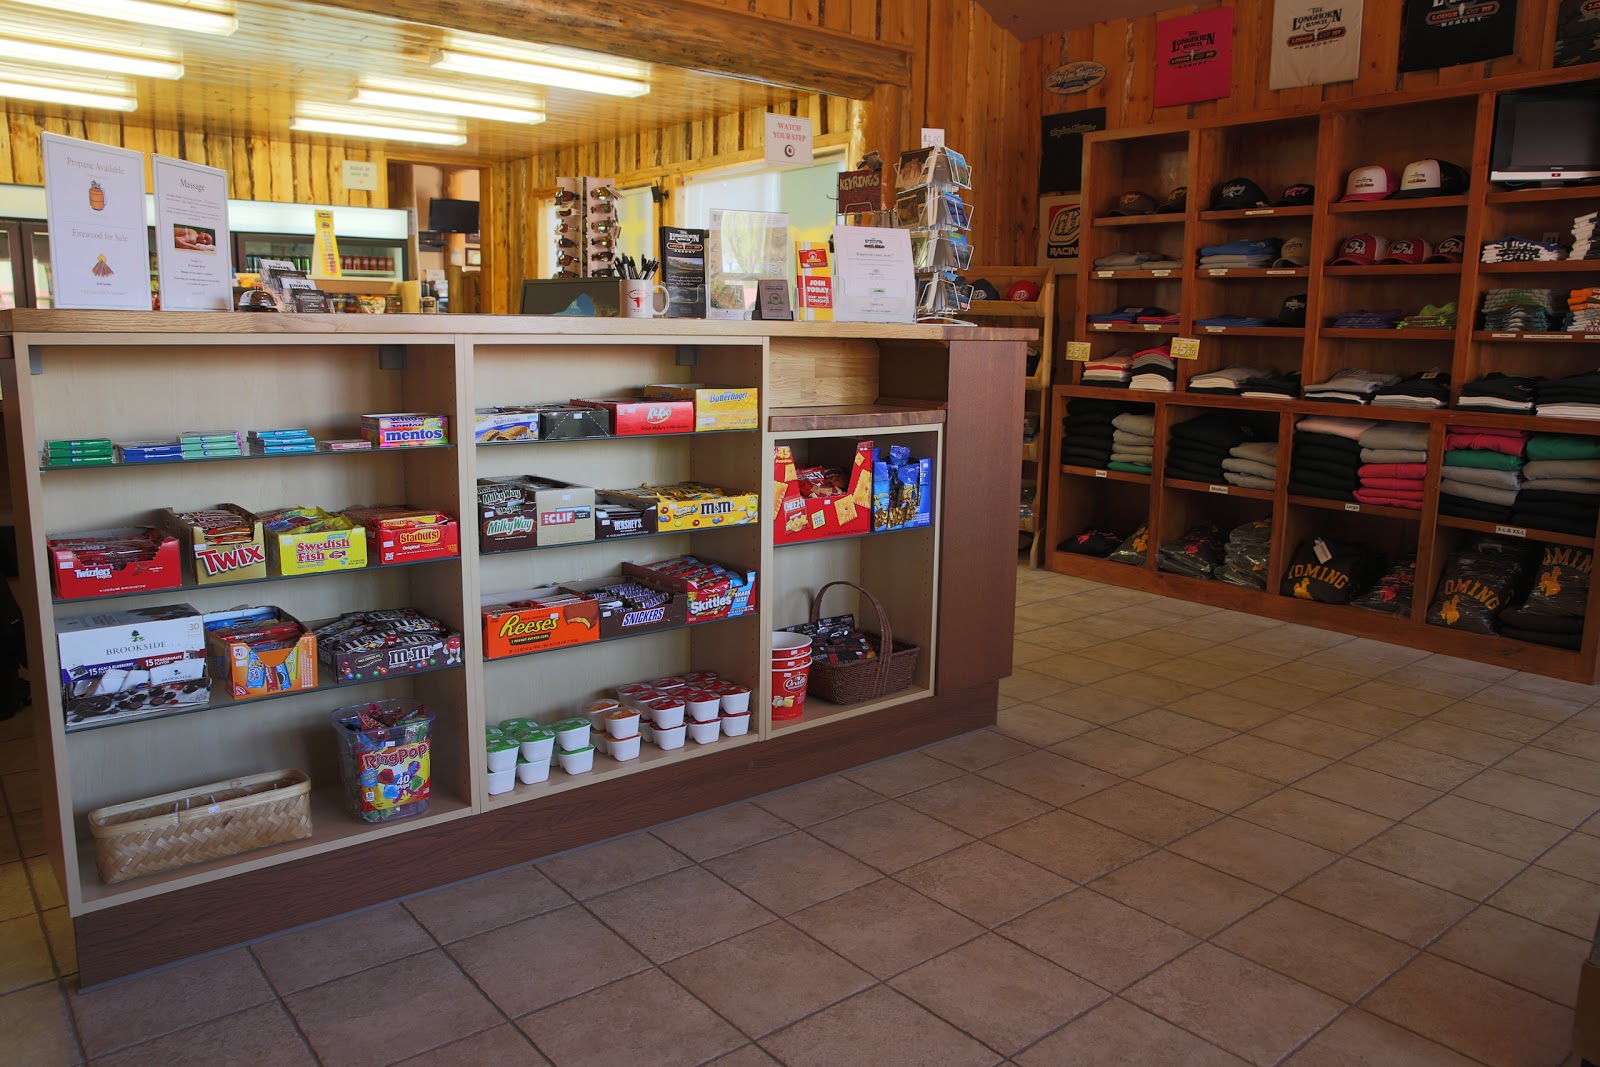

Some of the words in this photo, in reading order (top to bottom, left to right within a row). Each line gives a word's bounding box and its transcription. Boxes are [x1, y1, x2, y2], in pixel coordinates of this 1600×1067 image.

[1292, 8, 1342, 31] LONGHORN
[1431, 11, 1459, 20] LODGE
[1440, 16, 1482, 28] RESORT
[1172, 32, 1215, 52] LONGHORN
[777, 122, 802, 131] WATCH
[772, 131, 791, 140] YOUR
[791, 133, 807, 142] STEP
[67, 157, 94, 170] Propane
[96, 163, 125, 175] Available
[180, 179, 205, 192] Massage
[839, 173, 880, 191] KEYRINGS
[72, 229, 103, 240] Firewood
[104, 233, 113, 241] for
[114, 234, 128, 243] Sale
[1050, 247, 1079, 257] RACIN
[1067, 347, 1079, 357] 25
[1173, 344, 1187, 355] 25
[710, 391, 748, 403] Butterfinger
[385, 428, 443, 442] mentos
[777, 447, 791, 459] 45
[548, 512, 573, 523] CLIF
[613, 518, 642, 530] HERSHEY'S
[400, 529, 440, 543] Starburst
[297, 538, 350, 552] Swedish
[297, 551, 326, 563] Fish
[74, 567, 111, 578] Twizzlers
[690, 595, 732, 615] Skittles
[623, 608, 664, 626] SNICKERS
[189, 622, 199, 631] 30
[106, 641, 167, 656] BROOKSIDE
[145, 658, 154, 667] 15
[154, 654, 183, 663] POMEGRANATE
[88, 668, 98, 677] 15
[397, 775, 410, 785] 40
